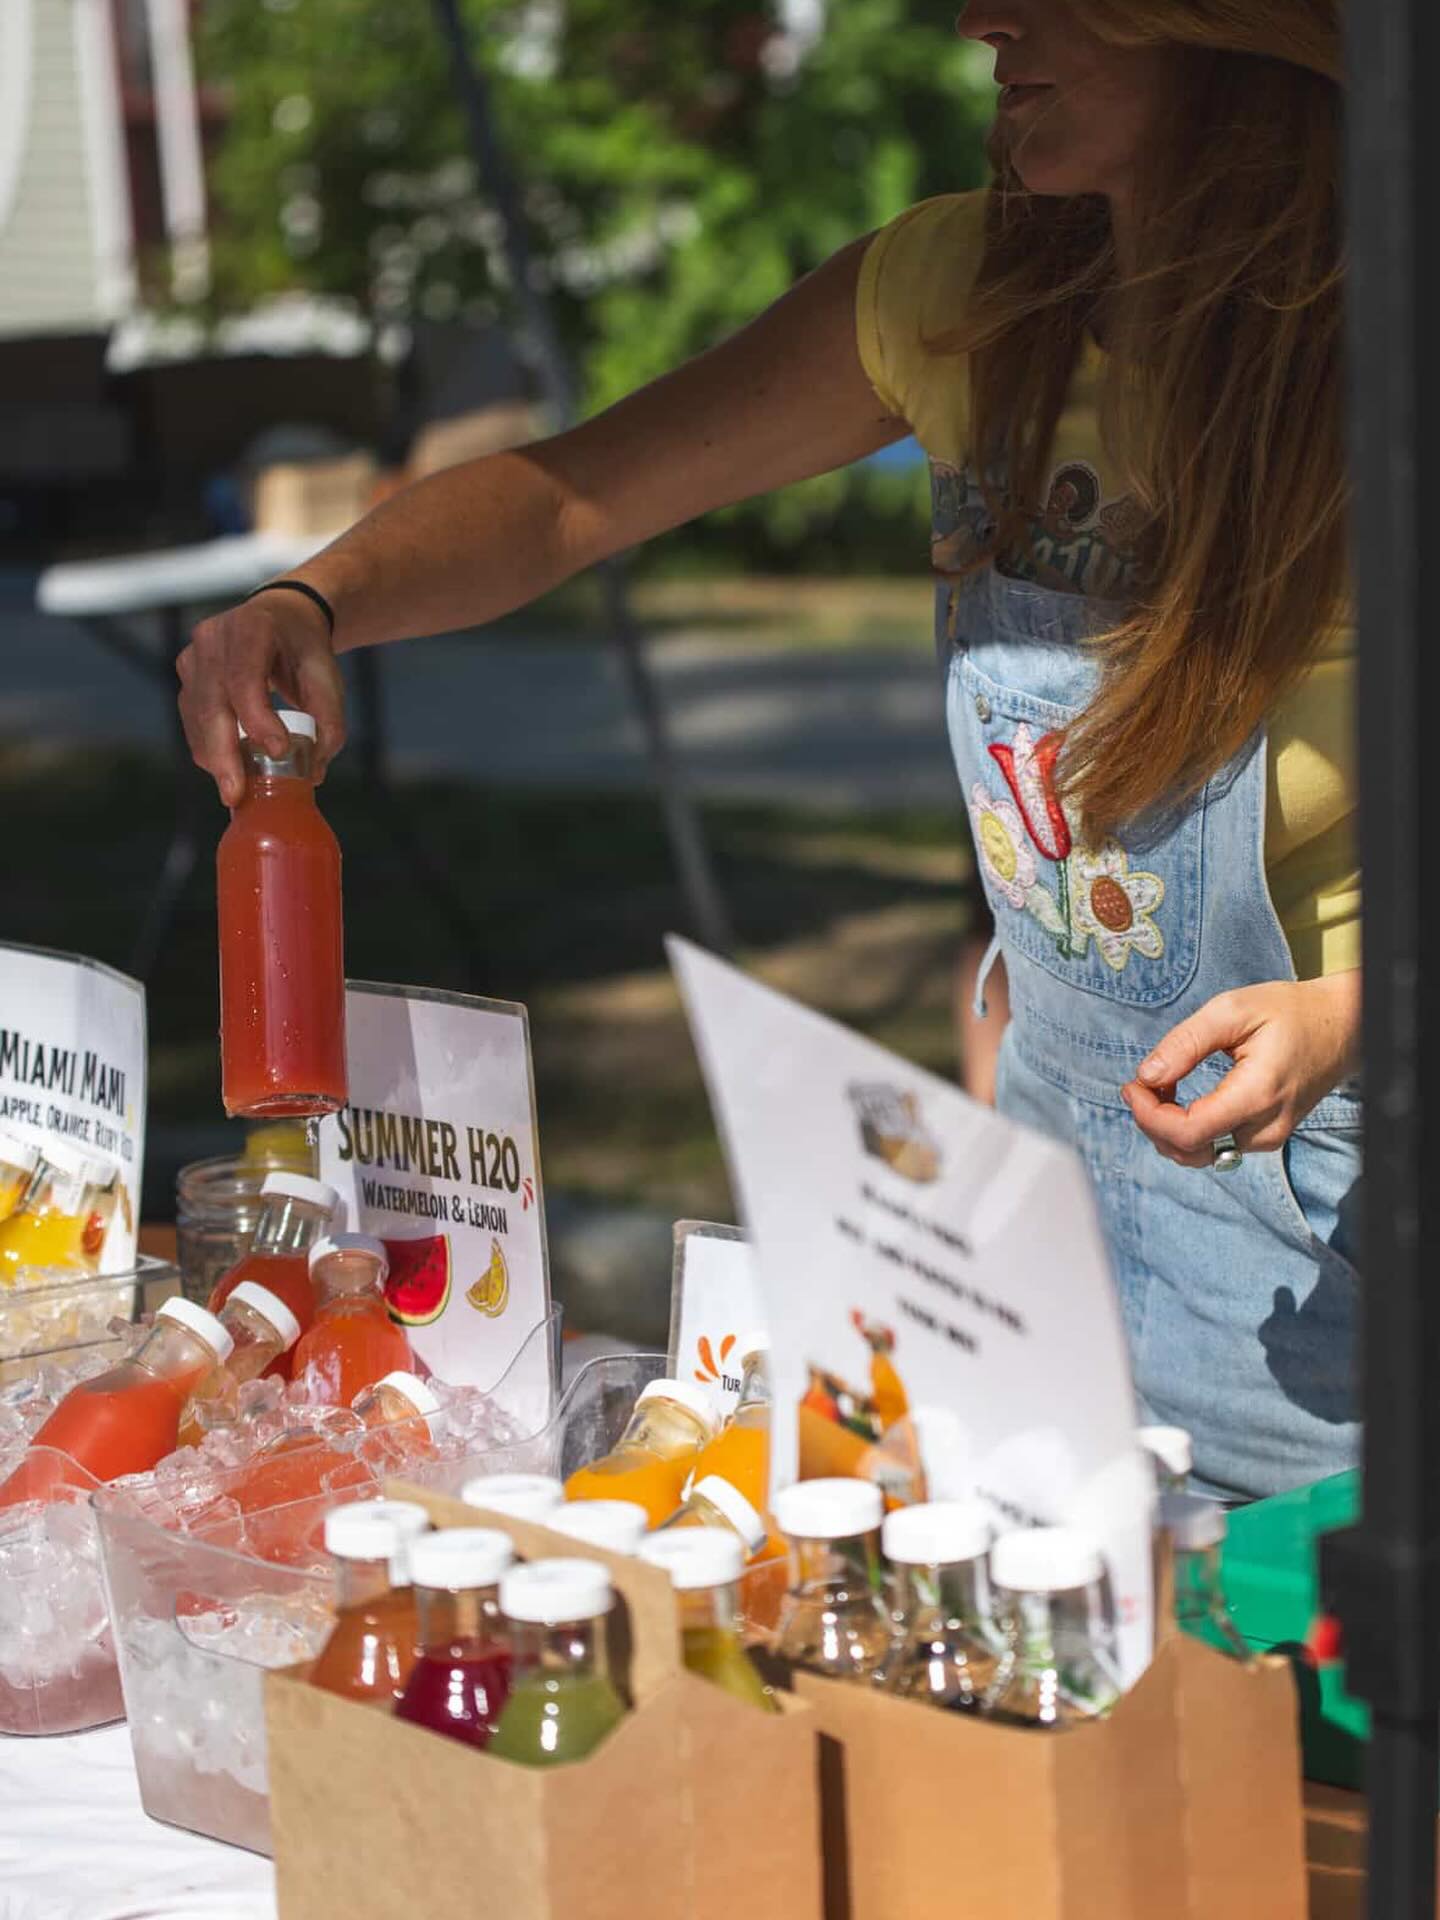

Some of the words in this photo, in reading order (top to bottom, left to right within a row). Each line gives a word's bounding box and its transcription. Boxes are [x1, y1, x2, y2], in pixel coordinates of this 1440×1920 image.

[0, 1030, 77, 1095] MIAMI
[81, 1051, 126, 1116] MAMI
[338, 1104, 462, 1181] SUMMER
[362, 1178, 449, 1221] WATERMELON
[451, 1195, 465, 1223] &
[467, 1197, 508, 1234] LEMON
